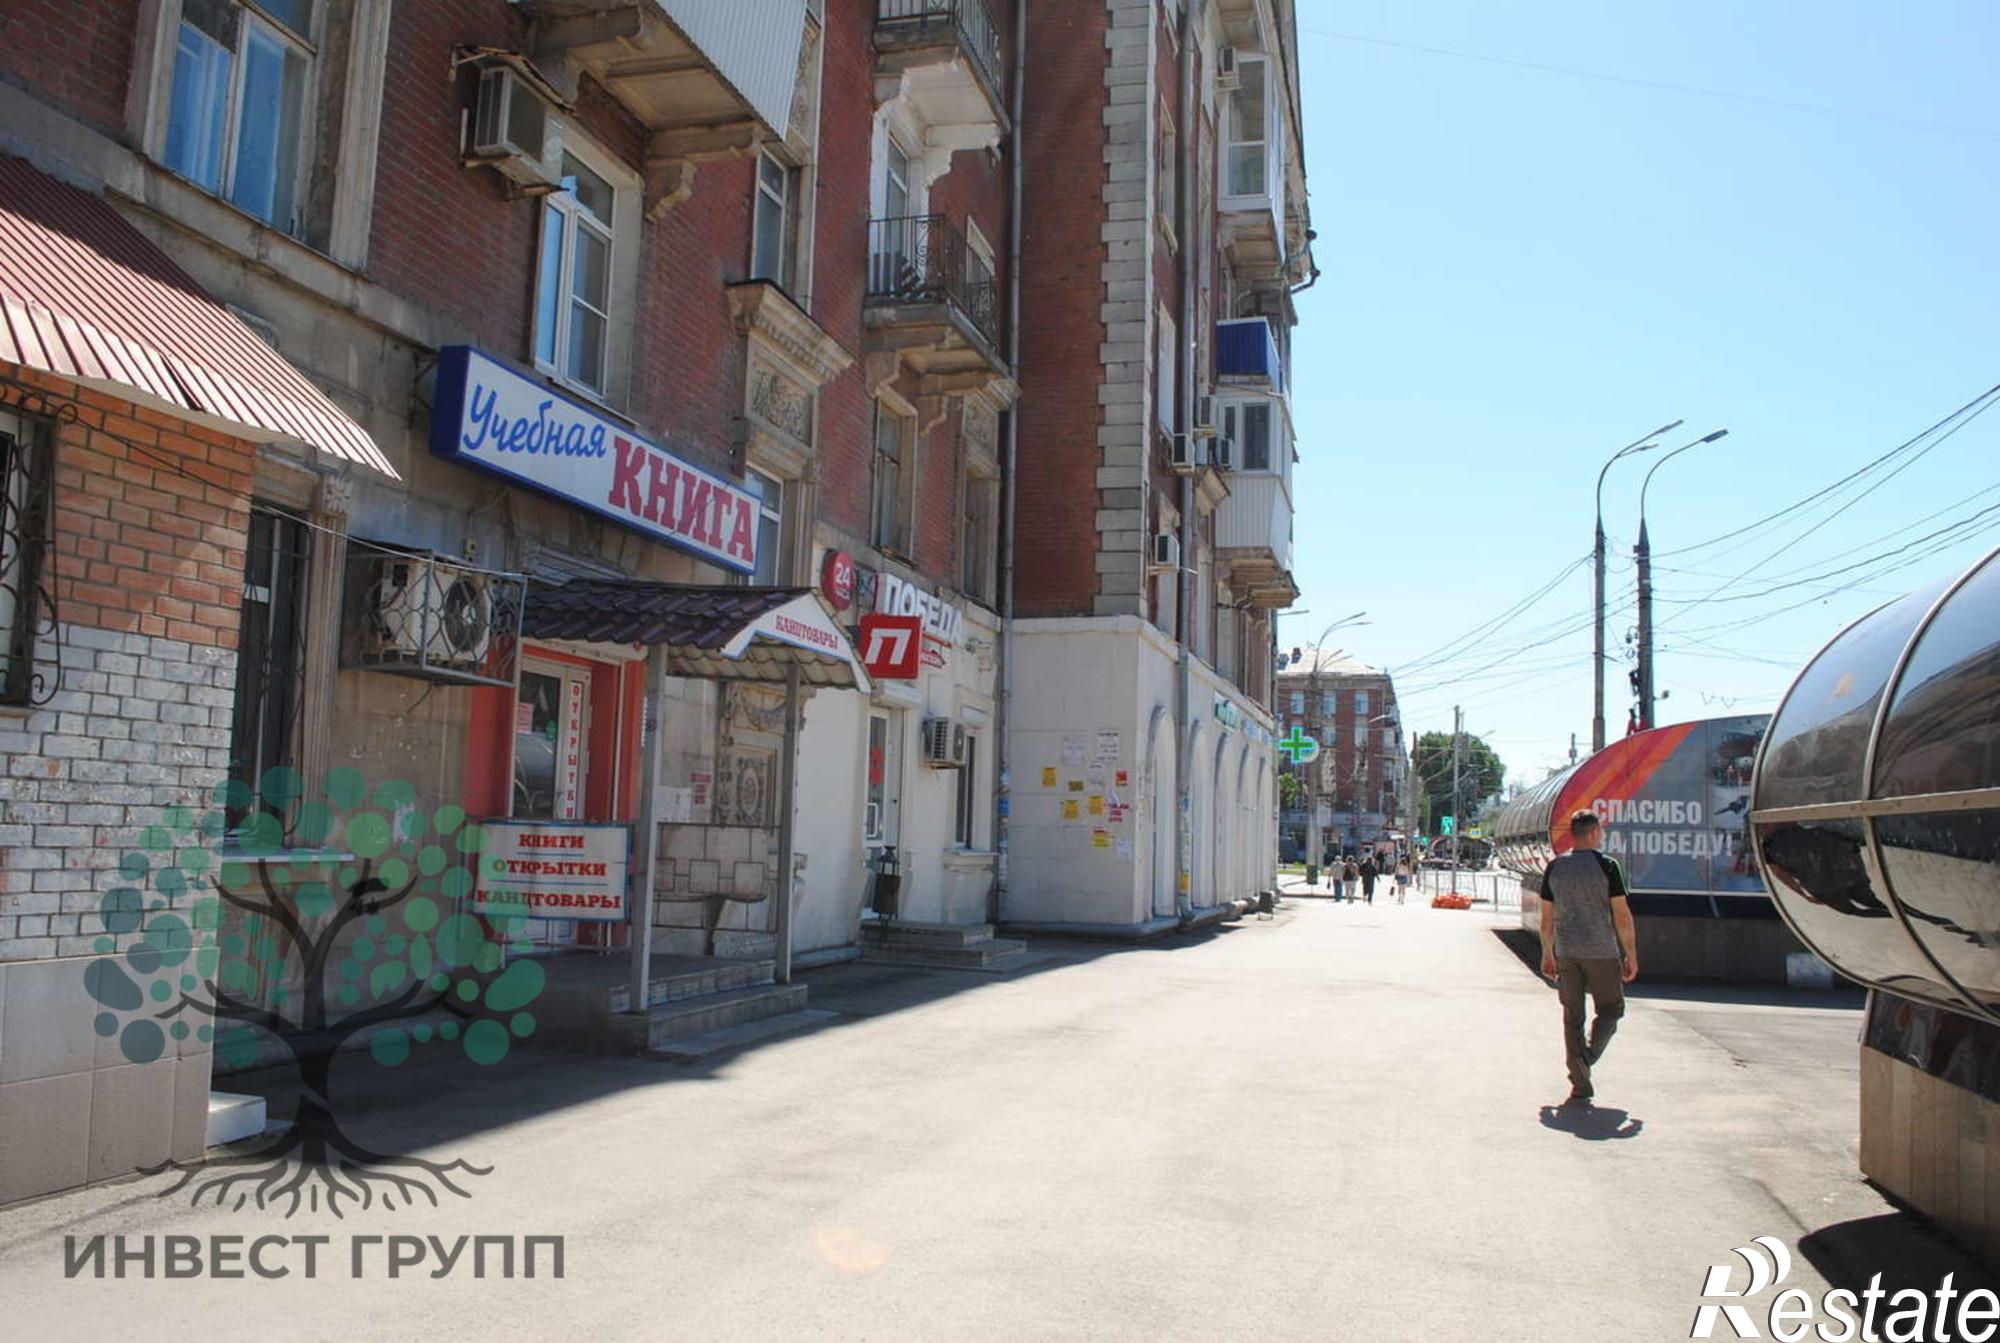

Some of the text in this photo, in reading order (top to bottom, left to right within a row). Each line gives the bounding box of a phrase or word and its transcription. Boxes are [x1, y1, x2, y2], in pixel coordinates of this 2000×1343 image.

[463, 384, 607, 458] Учебная
[608, 435, 755, 563] КНИГА
[865, 627, 912, 665] П
[566, 683, 581, 819] ОТКРЫТКИ
[1591, 798, 1702, 825] СПАСИБО
[518, 833, 585, 849] КНИГИ
[1631, 830, 1733, 859] ПОБЕДУ!
[493, 858, 608, 877] ОТКРЫТКИ
[476, 889, 622, 909] КАНЦТОВАРЫ
